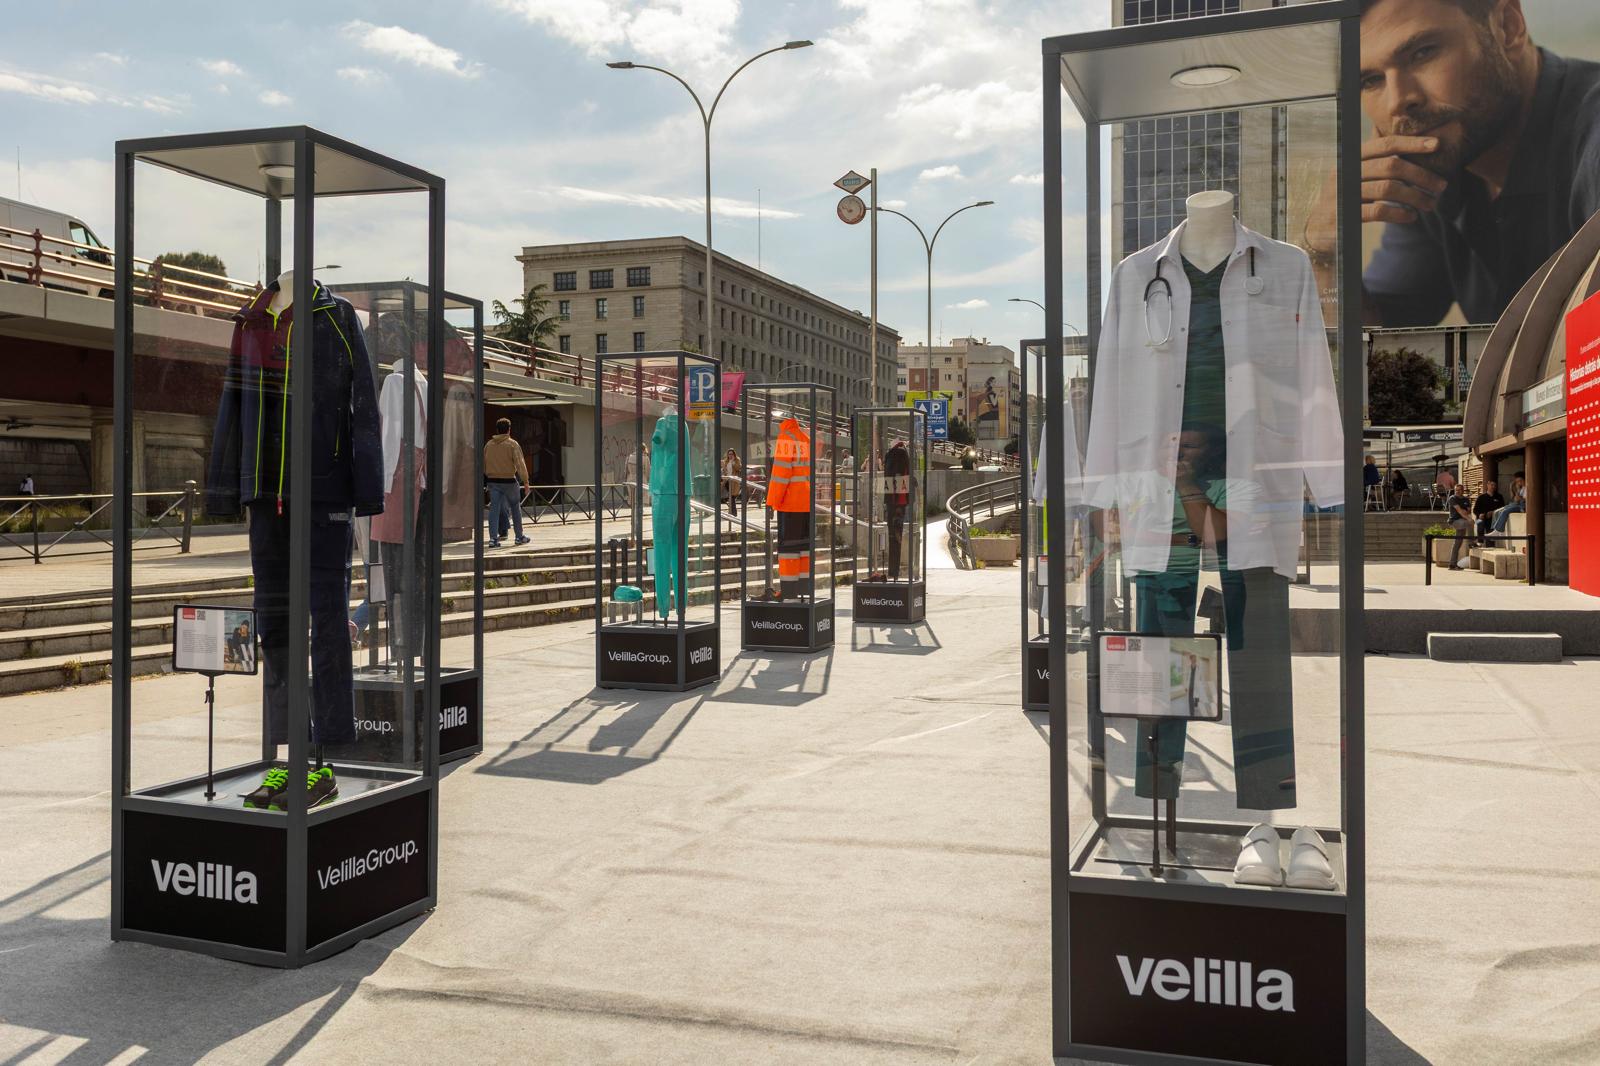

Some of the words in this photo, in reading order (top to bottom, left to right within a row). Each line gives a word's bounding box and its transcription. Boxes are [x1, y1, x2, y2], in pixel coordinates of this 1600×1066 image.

[931, 403, 941, 415] P
[861, 597, 905, 608] VelillaGroup.
[751, 620, 804, 632] VelillaGroup.
[608, 650, 672, 666] VelillaGroup.
[690, 646, 713, 665] velilla
[439, 705, 468, 732] lilla
[317, 839, 419, 890] VelillaGroup.
[151, 858, 259, 905] velilla
[1115, 954, 1296, 1013] velilla
